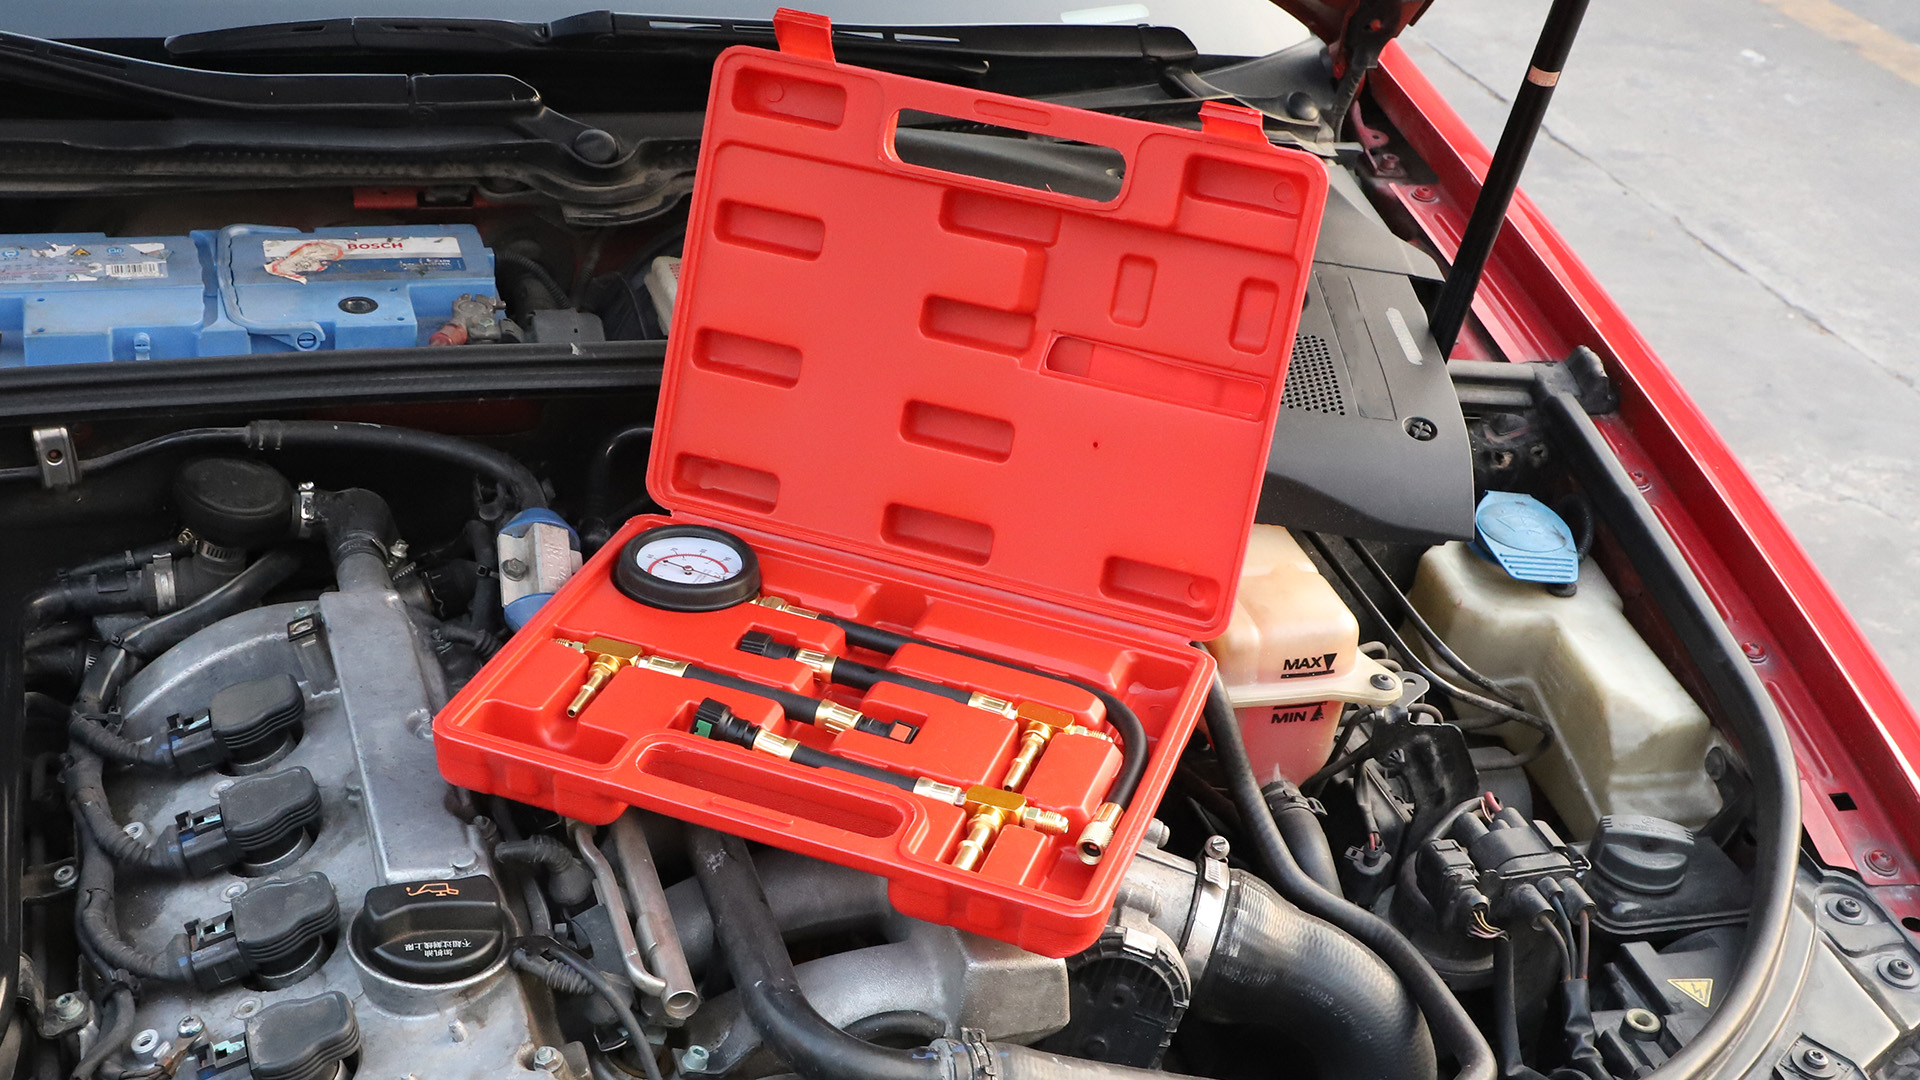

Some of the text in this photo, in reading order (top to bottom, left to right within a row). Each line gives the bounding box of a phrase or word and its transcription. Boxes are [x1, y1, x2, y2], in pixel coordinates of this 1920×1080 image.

[347, 242, 403, 250] BOSCH
[1283, 656, 1323, 671] MAX
[1271, 711, 1307, 724] MIN
[424, 948, 453, 957] 加机油
